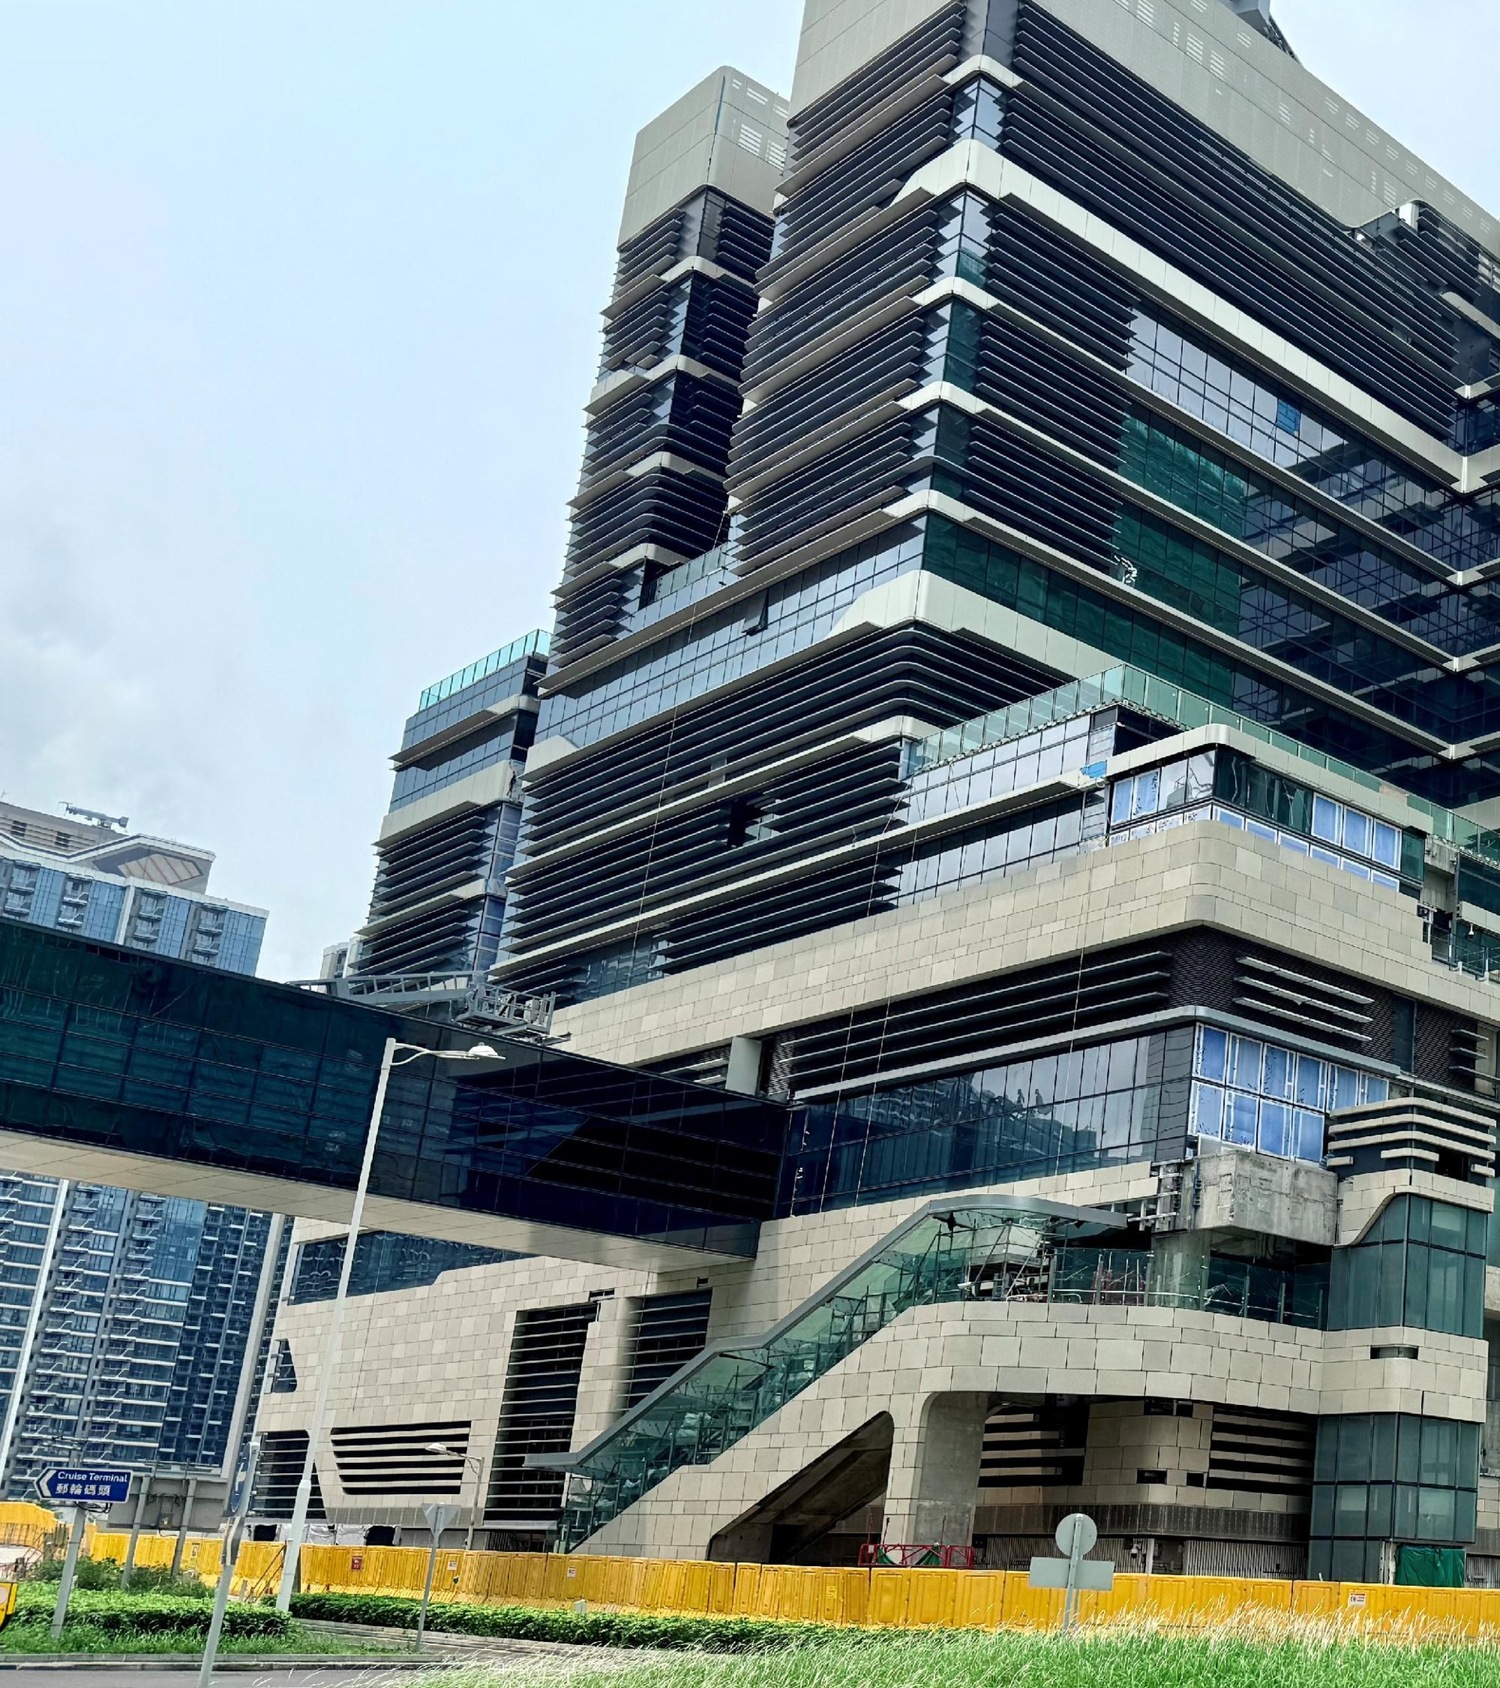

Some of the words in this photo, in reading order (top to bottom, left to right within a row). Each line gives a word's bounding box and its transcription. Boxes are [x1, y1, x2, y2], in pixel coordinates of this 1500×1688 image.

[57, 1471, 88, 1481] Cruise
[89, 1472, 128, 1483] Terminal
[55, 1482, 111, 1496] 郵輪碼頭
